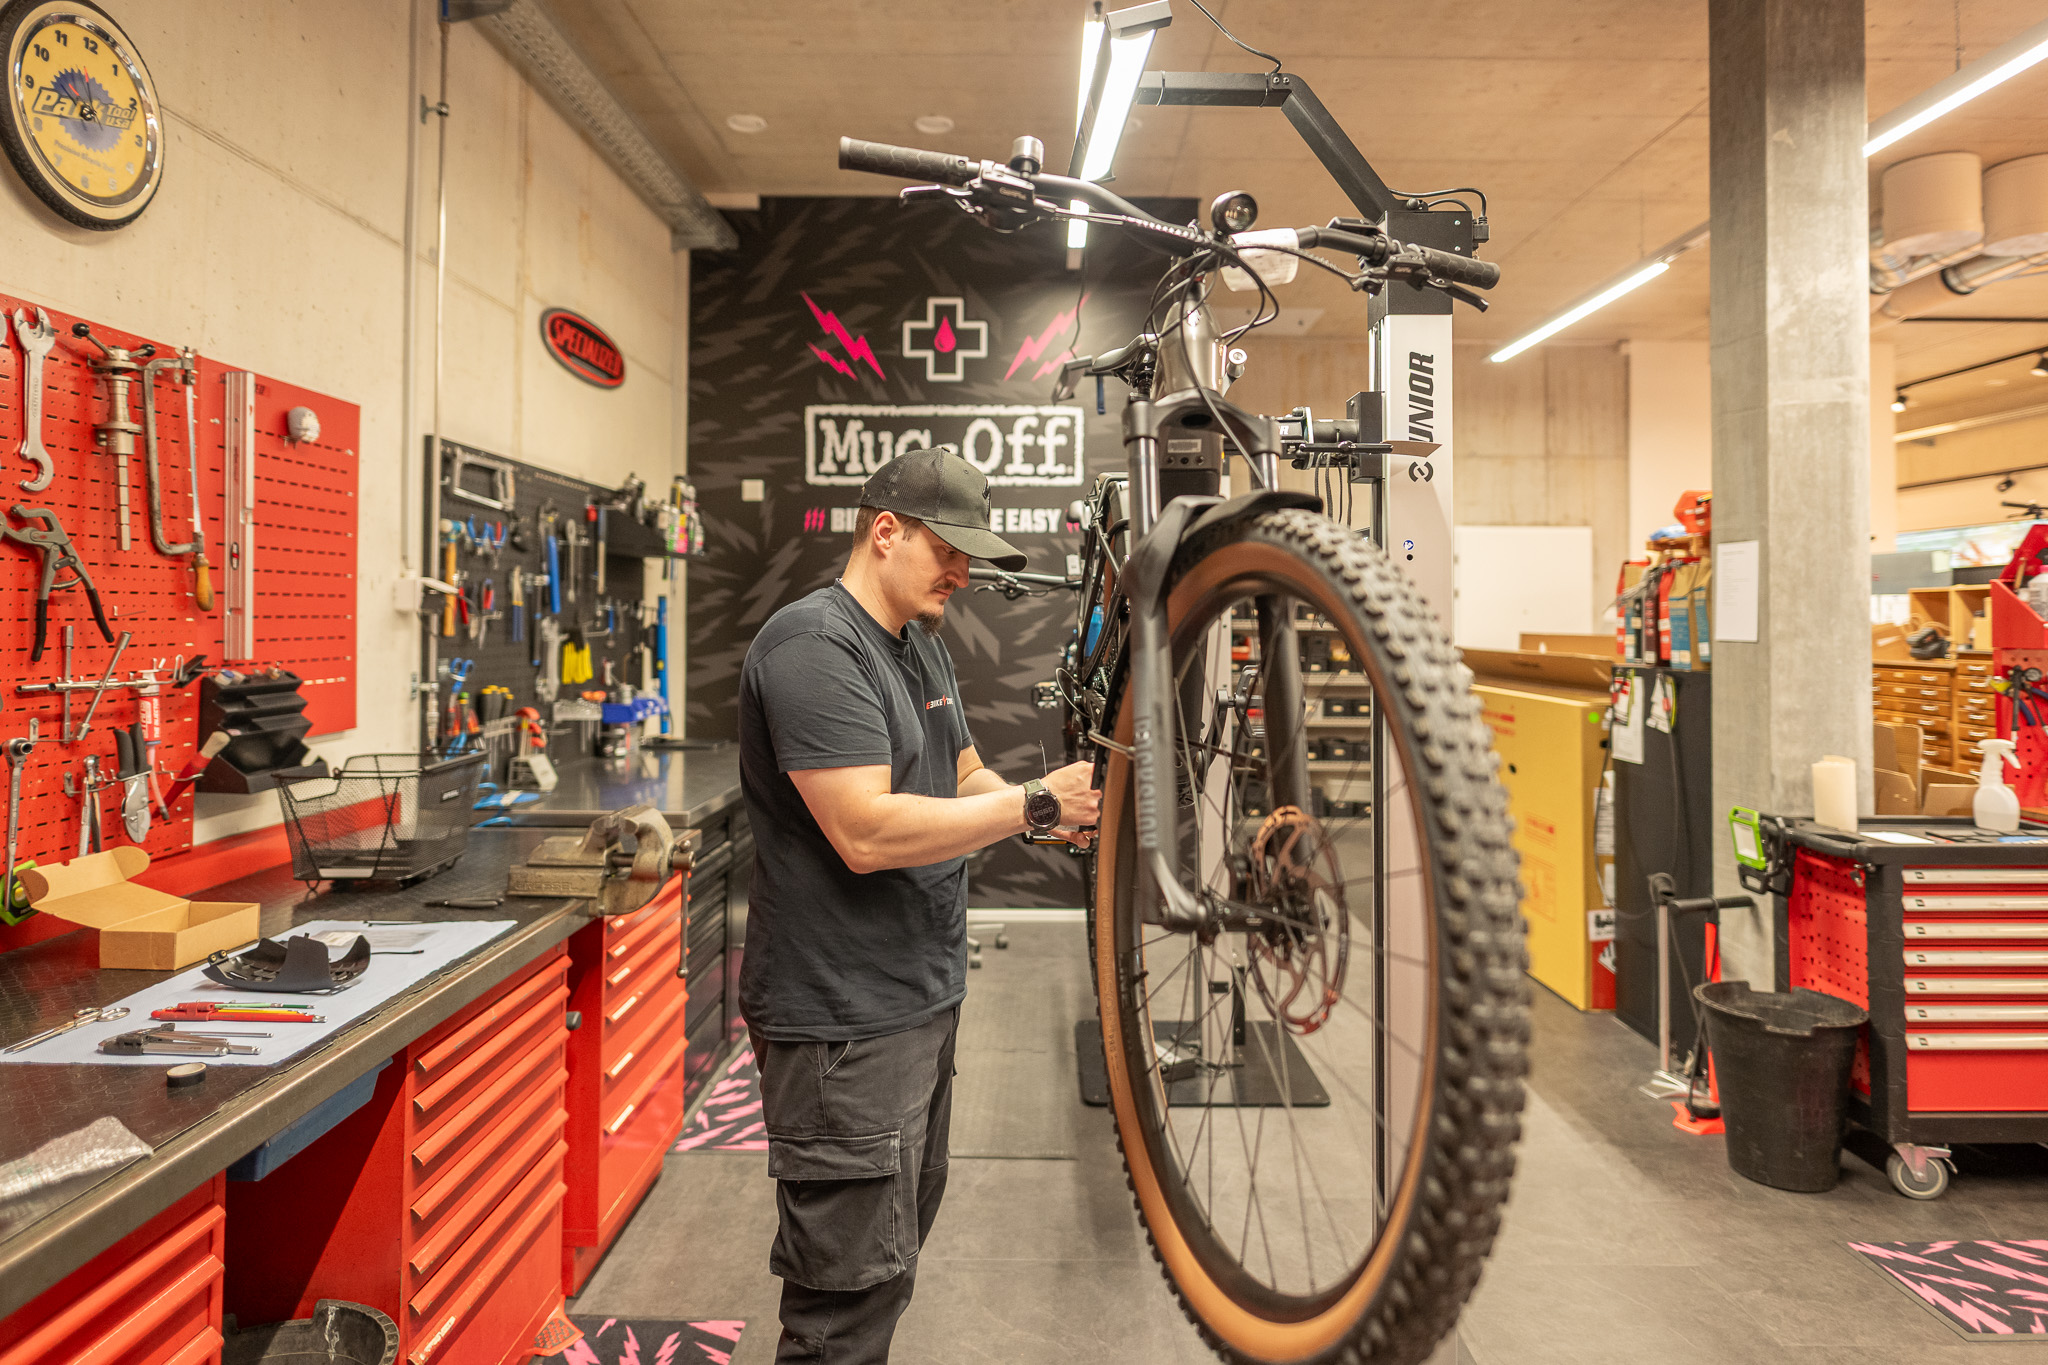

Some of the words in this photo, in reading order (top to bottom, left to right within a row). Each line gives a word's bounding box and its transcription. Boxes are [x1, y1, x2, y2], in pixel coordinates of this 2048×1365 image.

[55, 29, 68, 47] 11
[83, 36, 98, 55] 12
[34, 43, 50, 62] 10
[112, 64, 118, 77] 1
[25, 75, 34, 89] 9
[129, 97, 138, 110] 2
[135, 134, 143, 148] 3
[553, 319, 622, 377] SPECIALIZED
[1408, 351, 1434, 442] UNIOR
[1006, 507, 1062, 533] EASY
[1100, 896, 1118, 1032] GUNNISON
